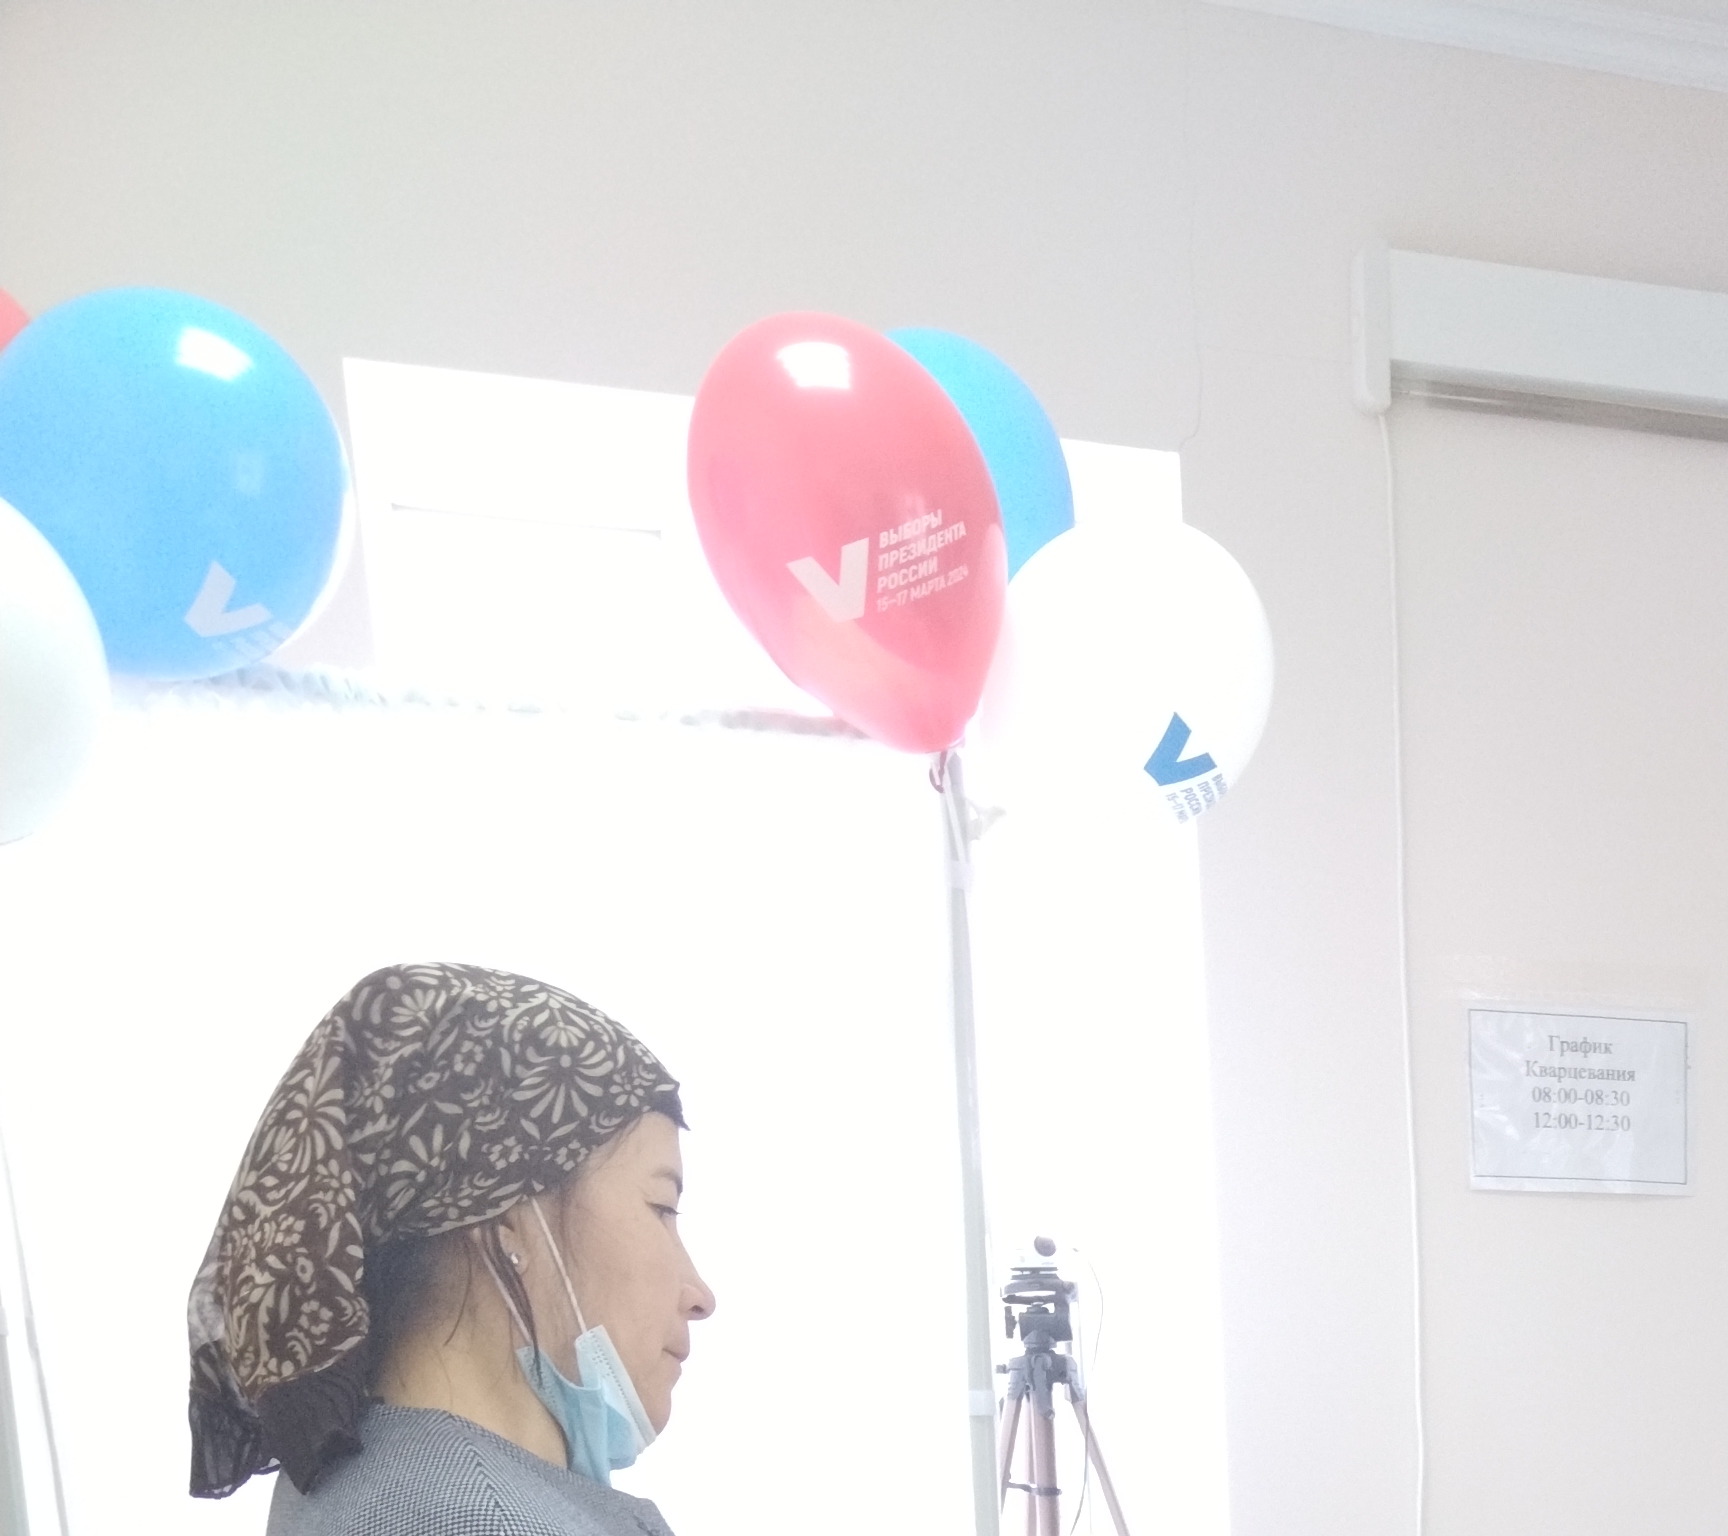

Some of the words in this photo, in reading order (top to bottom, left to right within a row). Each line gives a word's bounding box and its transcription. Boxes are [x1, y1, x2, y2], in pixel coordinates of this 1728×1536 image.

[879, 508, 943, 549] ВЫБОРЫ
[877, 521, 967, 571] ПРЕЗИДЕНТА
[876, 556, 938, 594] РОССИИ
[909, 577, 946, 602] МАРТА
[946, 563, 969, 587] 2024
[1547, 1034, 1614, 1057] График
[1524, 1060, 1637, 1083] Кварцевания
[1531, 1086, 1631, 1107] 08:00-08:30
[1533, 1111, 1631, 1132] 12:00-12:30
